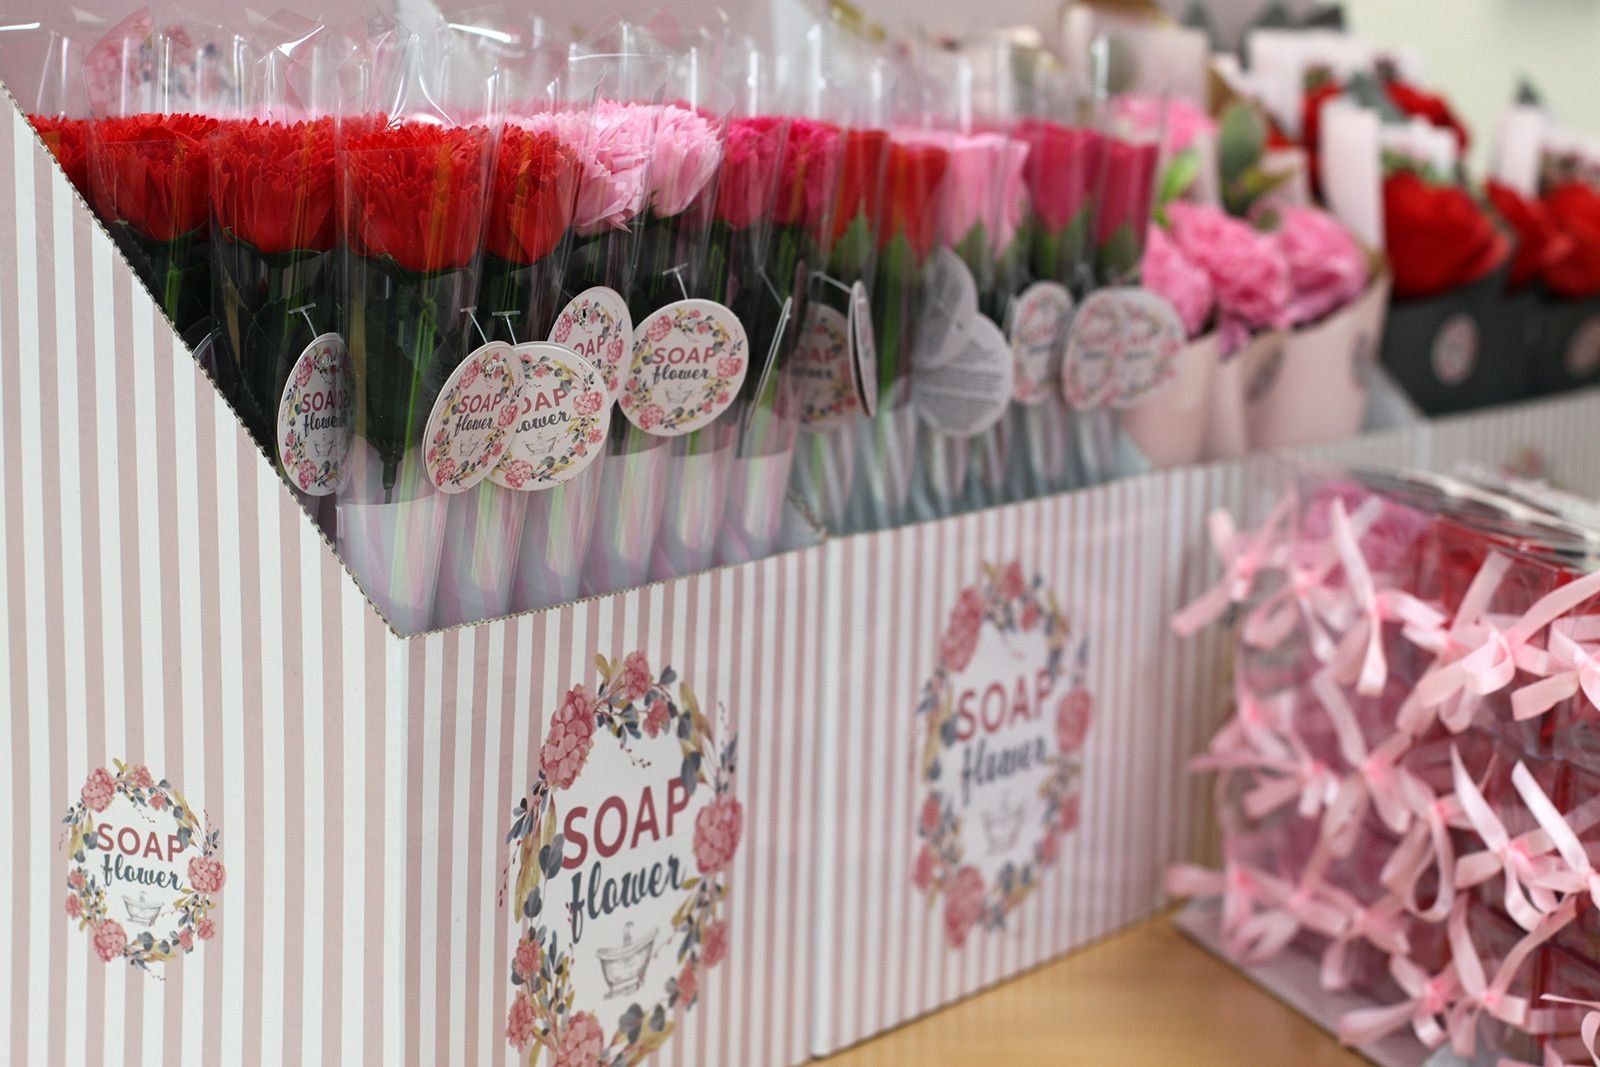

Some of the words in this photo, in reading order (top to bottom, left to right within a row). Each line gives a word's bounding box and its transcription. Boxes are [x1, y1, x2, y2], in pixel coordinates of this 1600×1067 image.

[573, 335, 606, 359] OAP
[651, 347, 717, 365] SOAP
[652, 364, 712, 385] flower
[458, 395, 502, 415] SOAP
[522, 387, 570, 415] OAP
[455, 413, 494, 437] flower
[515, 411, 572, 434] ower
[955, 668, 1054, 742] SOAP
[560, 776, 690, 870] SOAP
[96, 823, 186, 862] SOAP
[103, 853, 183, 891] flower
[568, 853, 687, 944] flower
